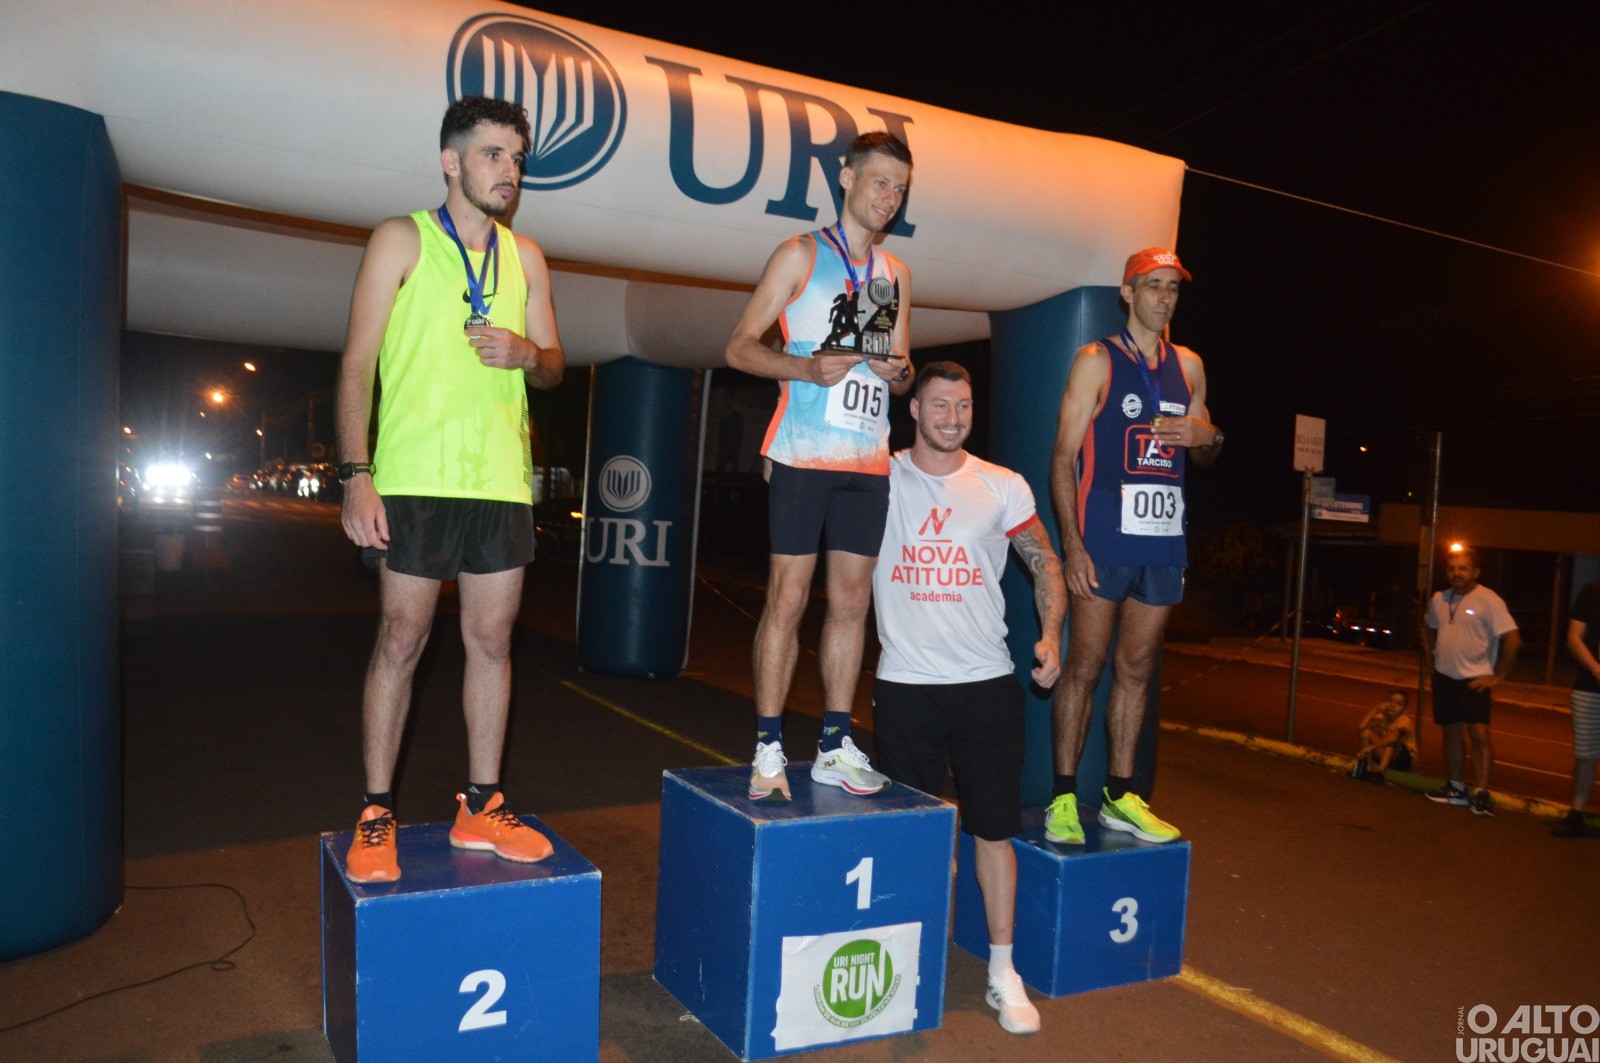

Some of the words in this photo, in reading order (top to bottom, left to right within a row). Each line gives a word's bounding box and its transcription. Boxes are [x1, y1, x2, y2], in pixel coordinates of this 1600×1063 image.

[644, 55, 916, 238] URI
[842, 379, 882, 418] 015
[1137, 457, 1173, 468] TARCISO
[1133, 490, 1177, 519] 003
[584, 517, 673, 567] URI
[902, 544, 970, 565] NOVA
[890, 564, 984, 586] ATITUDE
[910, 590, 963, 602] academia
[845, 856, 874, 910] 1
[1109, 896, 1138, 943] 3
[830, 944, 886, 1015] RUN
[833, 955, 848, 968] URI
[850, 952, 875, 966] NIGHT
[458, 968, 507, 1033] 2
